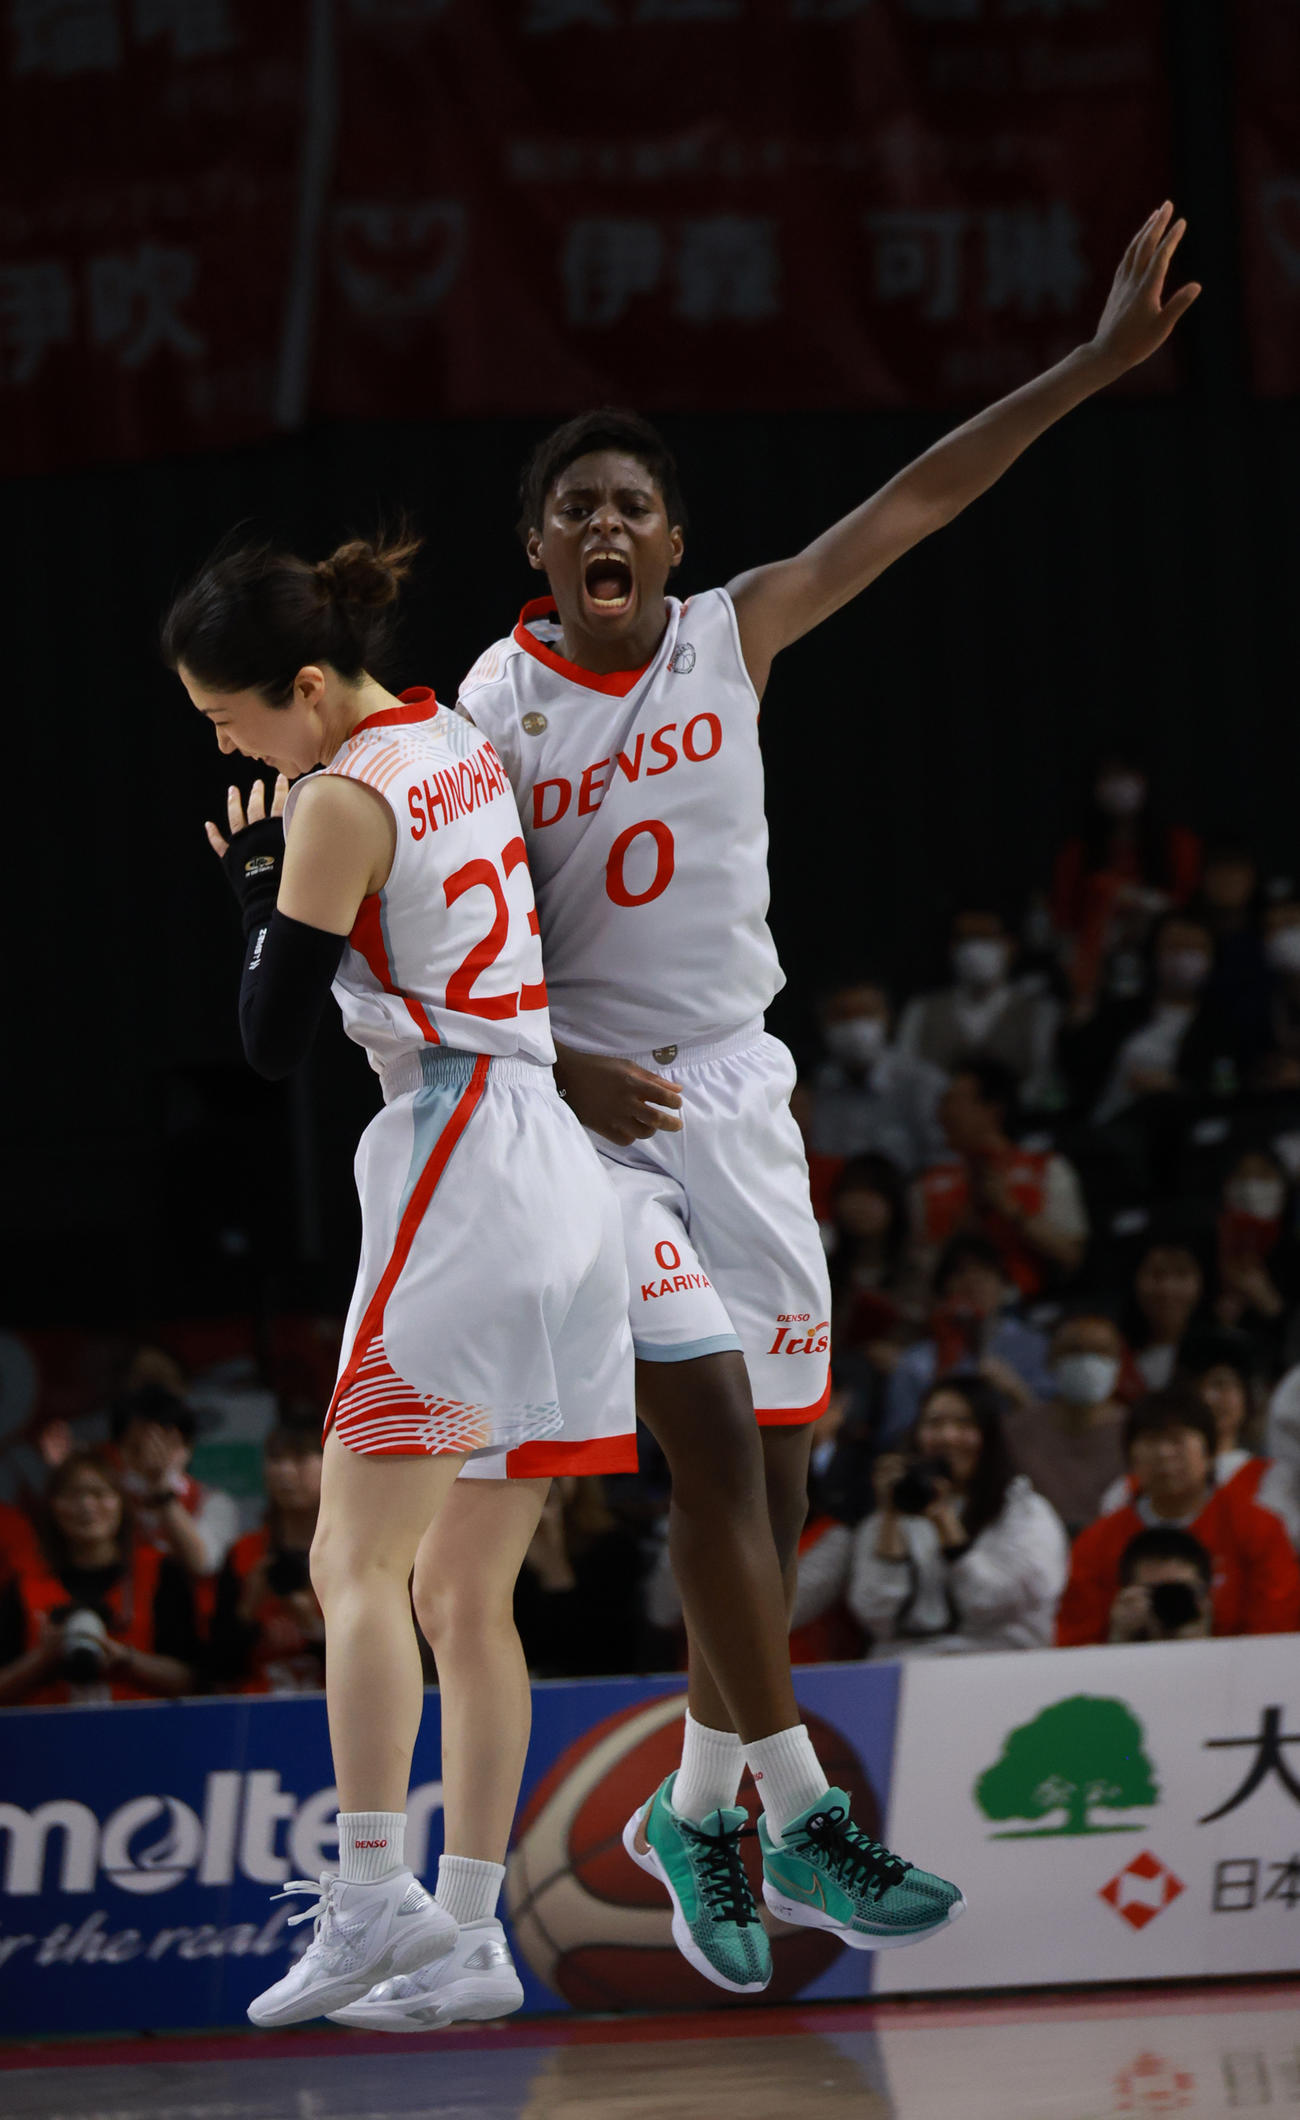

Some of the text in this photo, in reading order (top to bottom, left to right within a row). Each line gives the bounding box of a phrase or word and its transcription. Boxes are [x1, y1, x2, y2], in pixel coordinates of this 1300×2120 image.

[532, 712, 723, 830] DENSO
[605, 819, 675, 907] 0
[442, 836, 550, 1021] 23
[654, 1240, 681, 1270] 0
[640, 1274, 712, 1302] KARIYA
[776, 1313, 811, 1322] DENSO
[767, 1327, 829, 1355] Iris
[355, 1839, 388, 1849] DENSO
[34, 1909, 145, 1968] the
[145, 1902, 298, 1962] real
